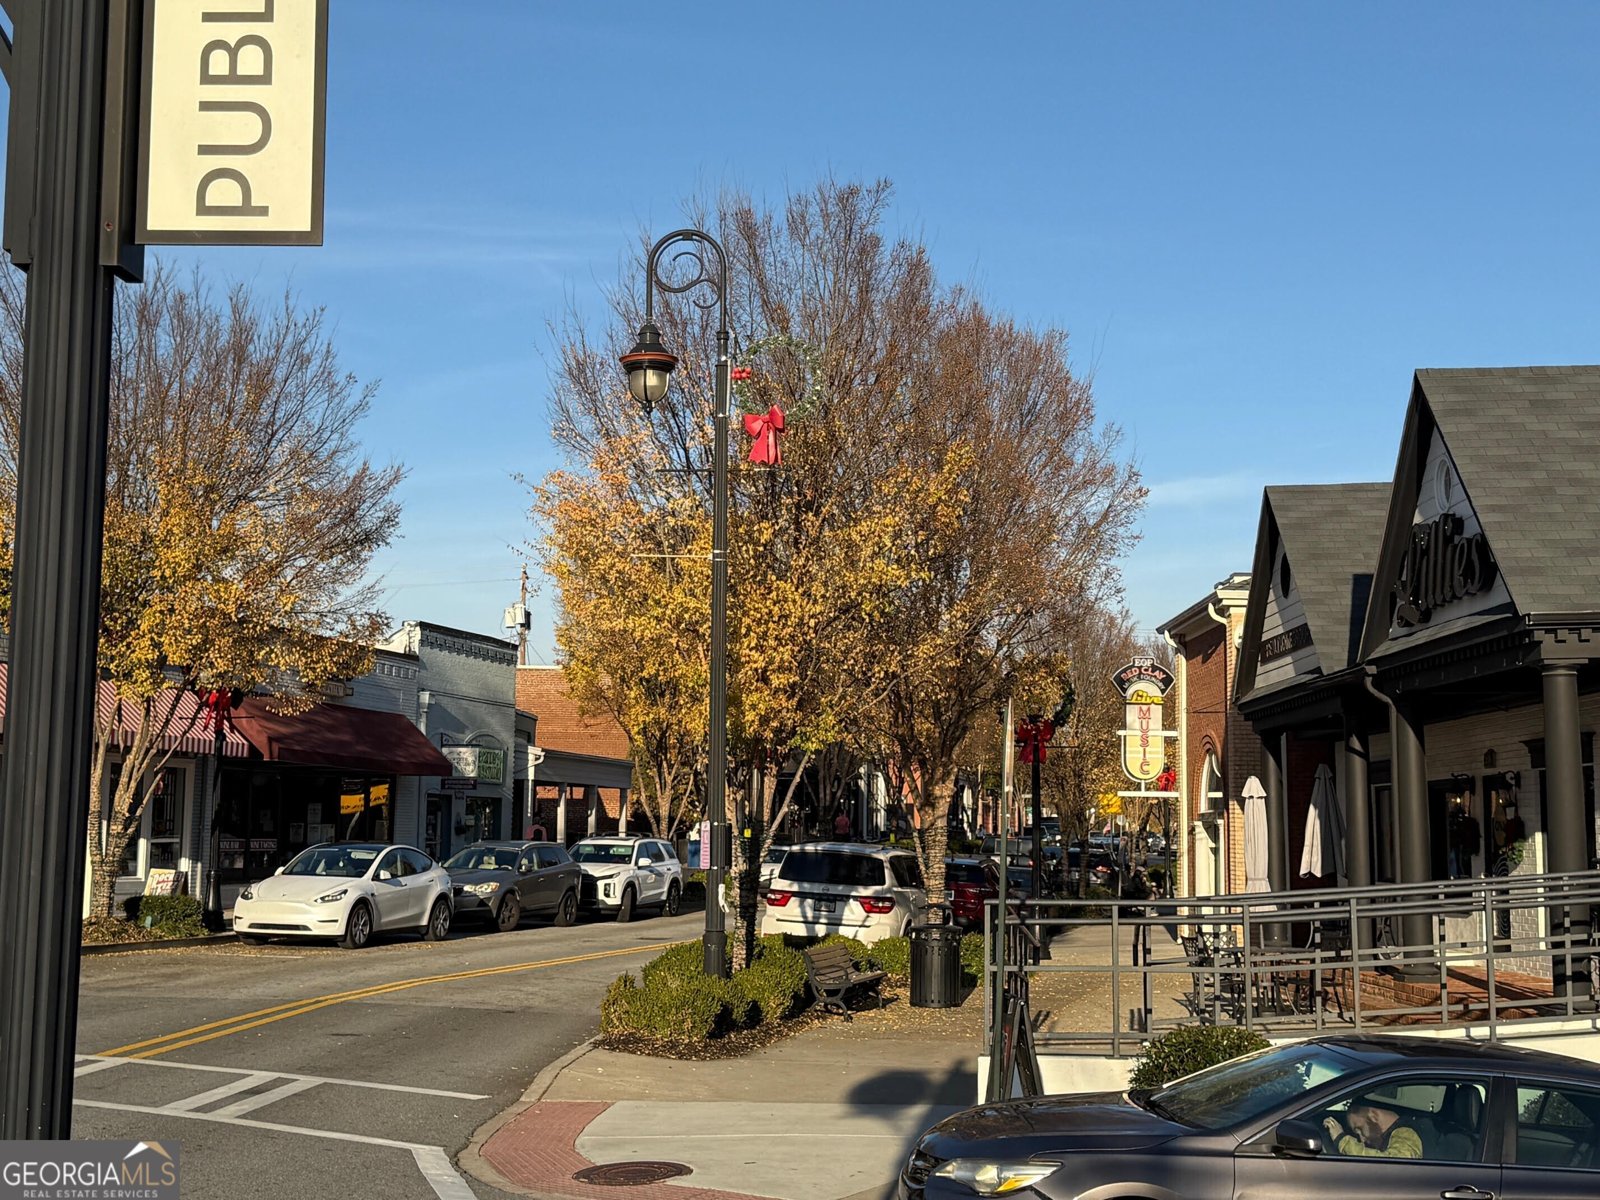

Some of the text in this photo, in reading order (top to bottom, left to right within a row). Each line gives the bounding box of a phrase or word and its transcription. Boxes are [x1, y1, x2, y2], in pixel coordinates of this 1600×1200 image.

[195, 0, 274, 217] PUBL
[1121, 667, 1166, 680] RED CLAY
[1128, 689, 1164, 704] Live
[1138, 706, 1151, 775] MUSIC
